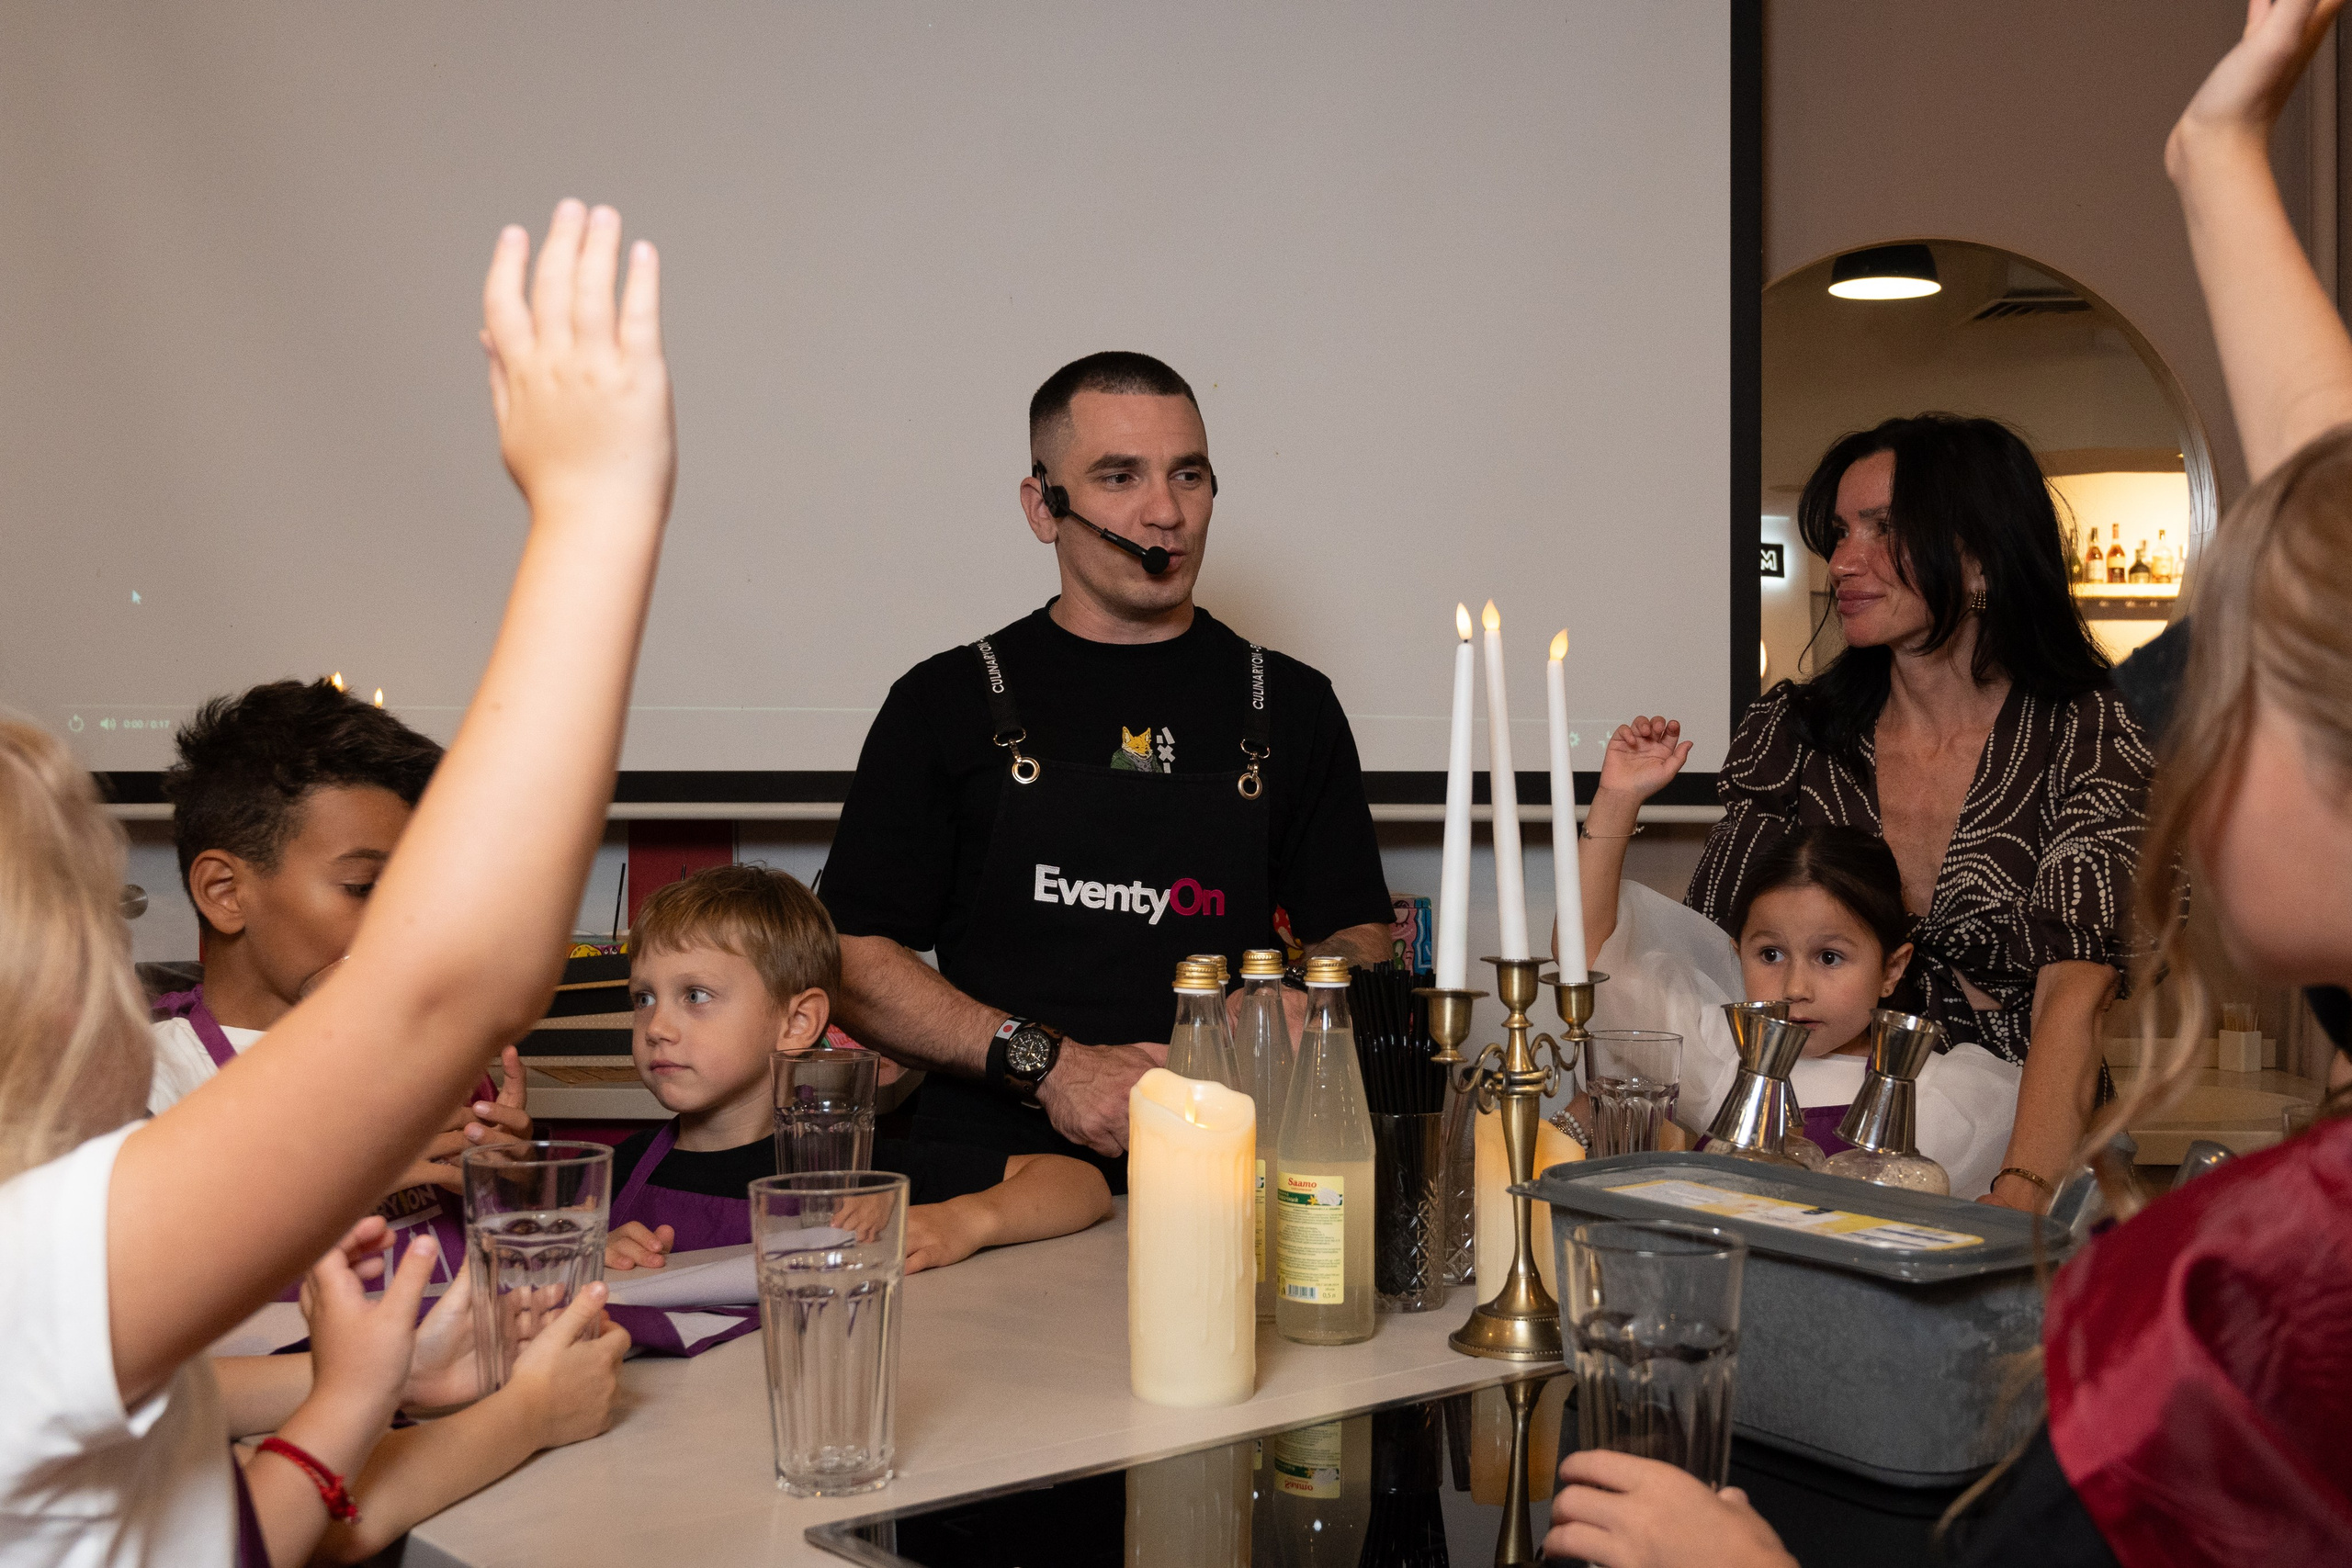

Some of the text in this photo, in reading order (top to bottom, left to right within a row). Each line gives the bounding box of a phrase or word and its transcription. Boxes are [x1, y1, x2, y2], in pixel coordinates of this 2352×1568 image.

[977, 642, 1005, 694] CULINARYON
[1251, 652, 1264, 710] CULINARYON
[1034, 863, 1226, 925] EventyOn
[1288, 1177, 1317, 1188] Saamo
